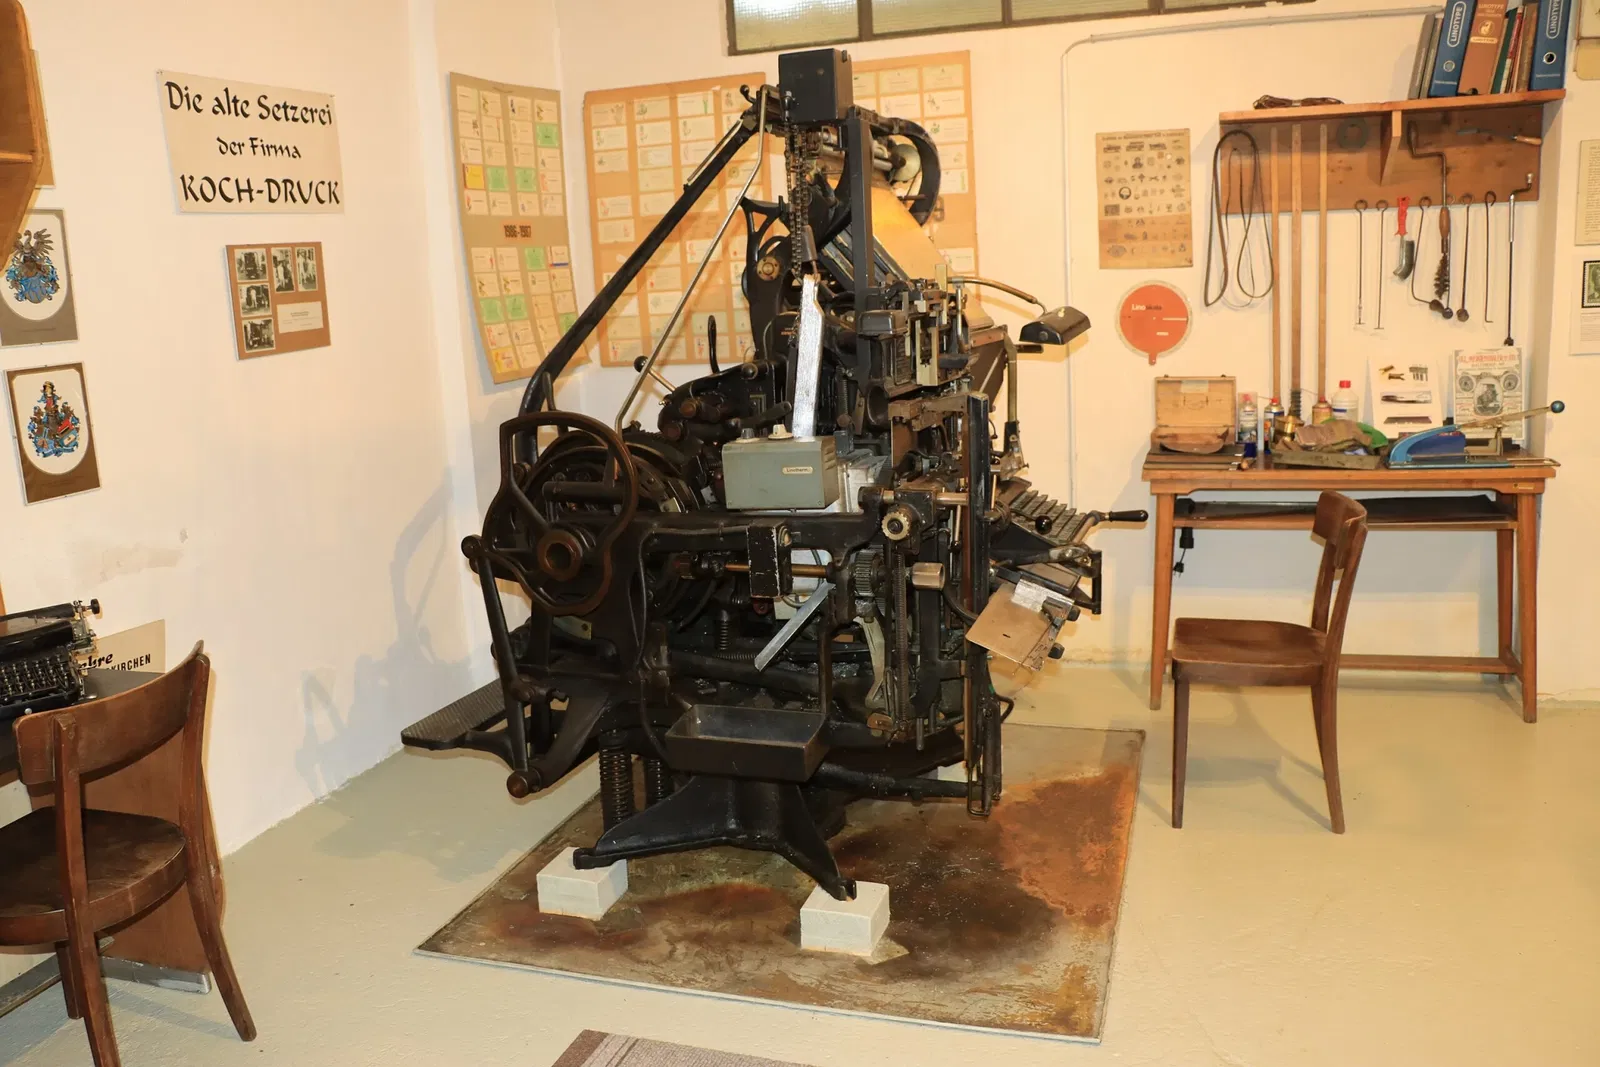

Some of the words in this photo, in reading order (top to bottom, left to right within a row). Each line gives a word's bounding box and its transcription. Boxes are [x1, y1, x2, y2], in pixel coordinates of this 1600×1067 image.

[1451, 6, 1463, 42] LINOTYPE
[165, 81, 204, 114] Die
[212, 87, 250, 119] alte
[257, 94, 333, 126] Setzerei
[216, 136, 245, 156] der
[249, 136, 302, 159] Firma
[180, 174, 340, 205] KOCH-DRUCK
